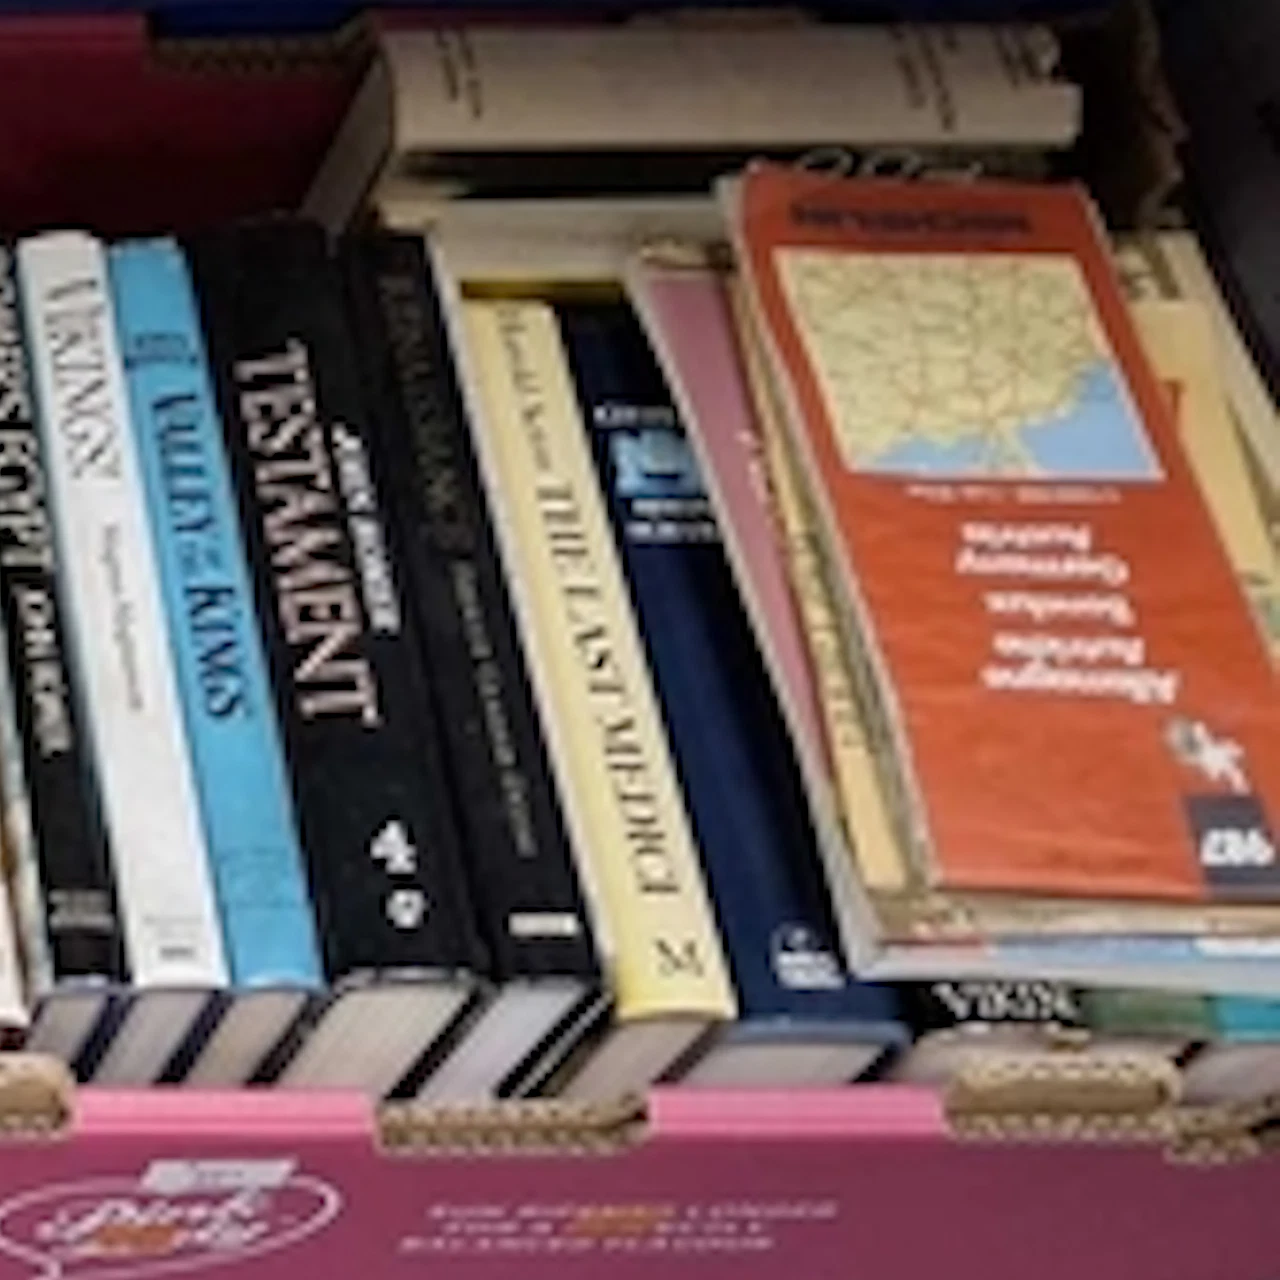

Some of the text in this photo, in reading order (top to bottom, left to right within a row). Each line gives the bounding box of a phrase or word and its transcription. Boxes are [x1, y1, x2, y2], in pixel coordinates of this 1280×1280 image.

[148, 389, 222, 538] VALLEY
[532, 475, 595, 577] THE
[226, 332, 383, 743] TESTAMENT
[956, 549, 1128, 584] Germany
[183, 579, 261, 724] KINGS
[560, 577, 630, 709] LAST
[595, 710, 682, 904] MEDICI
